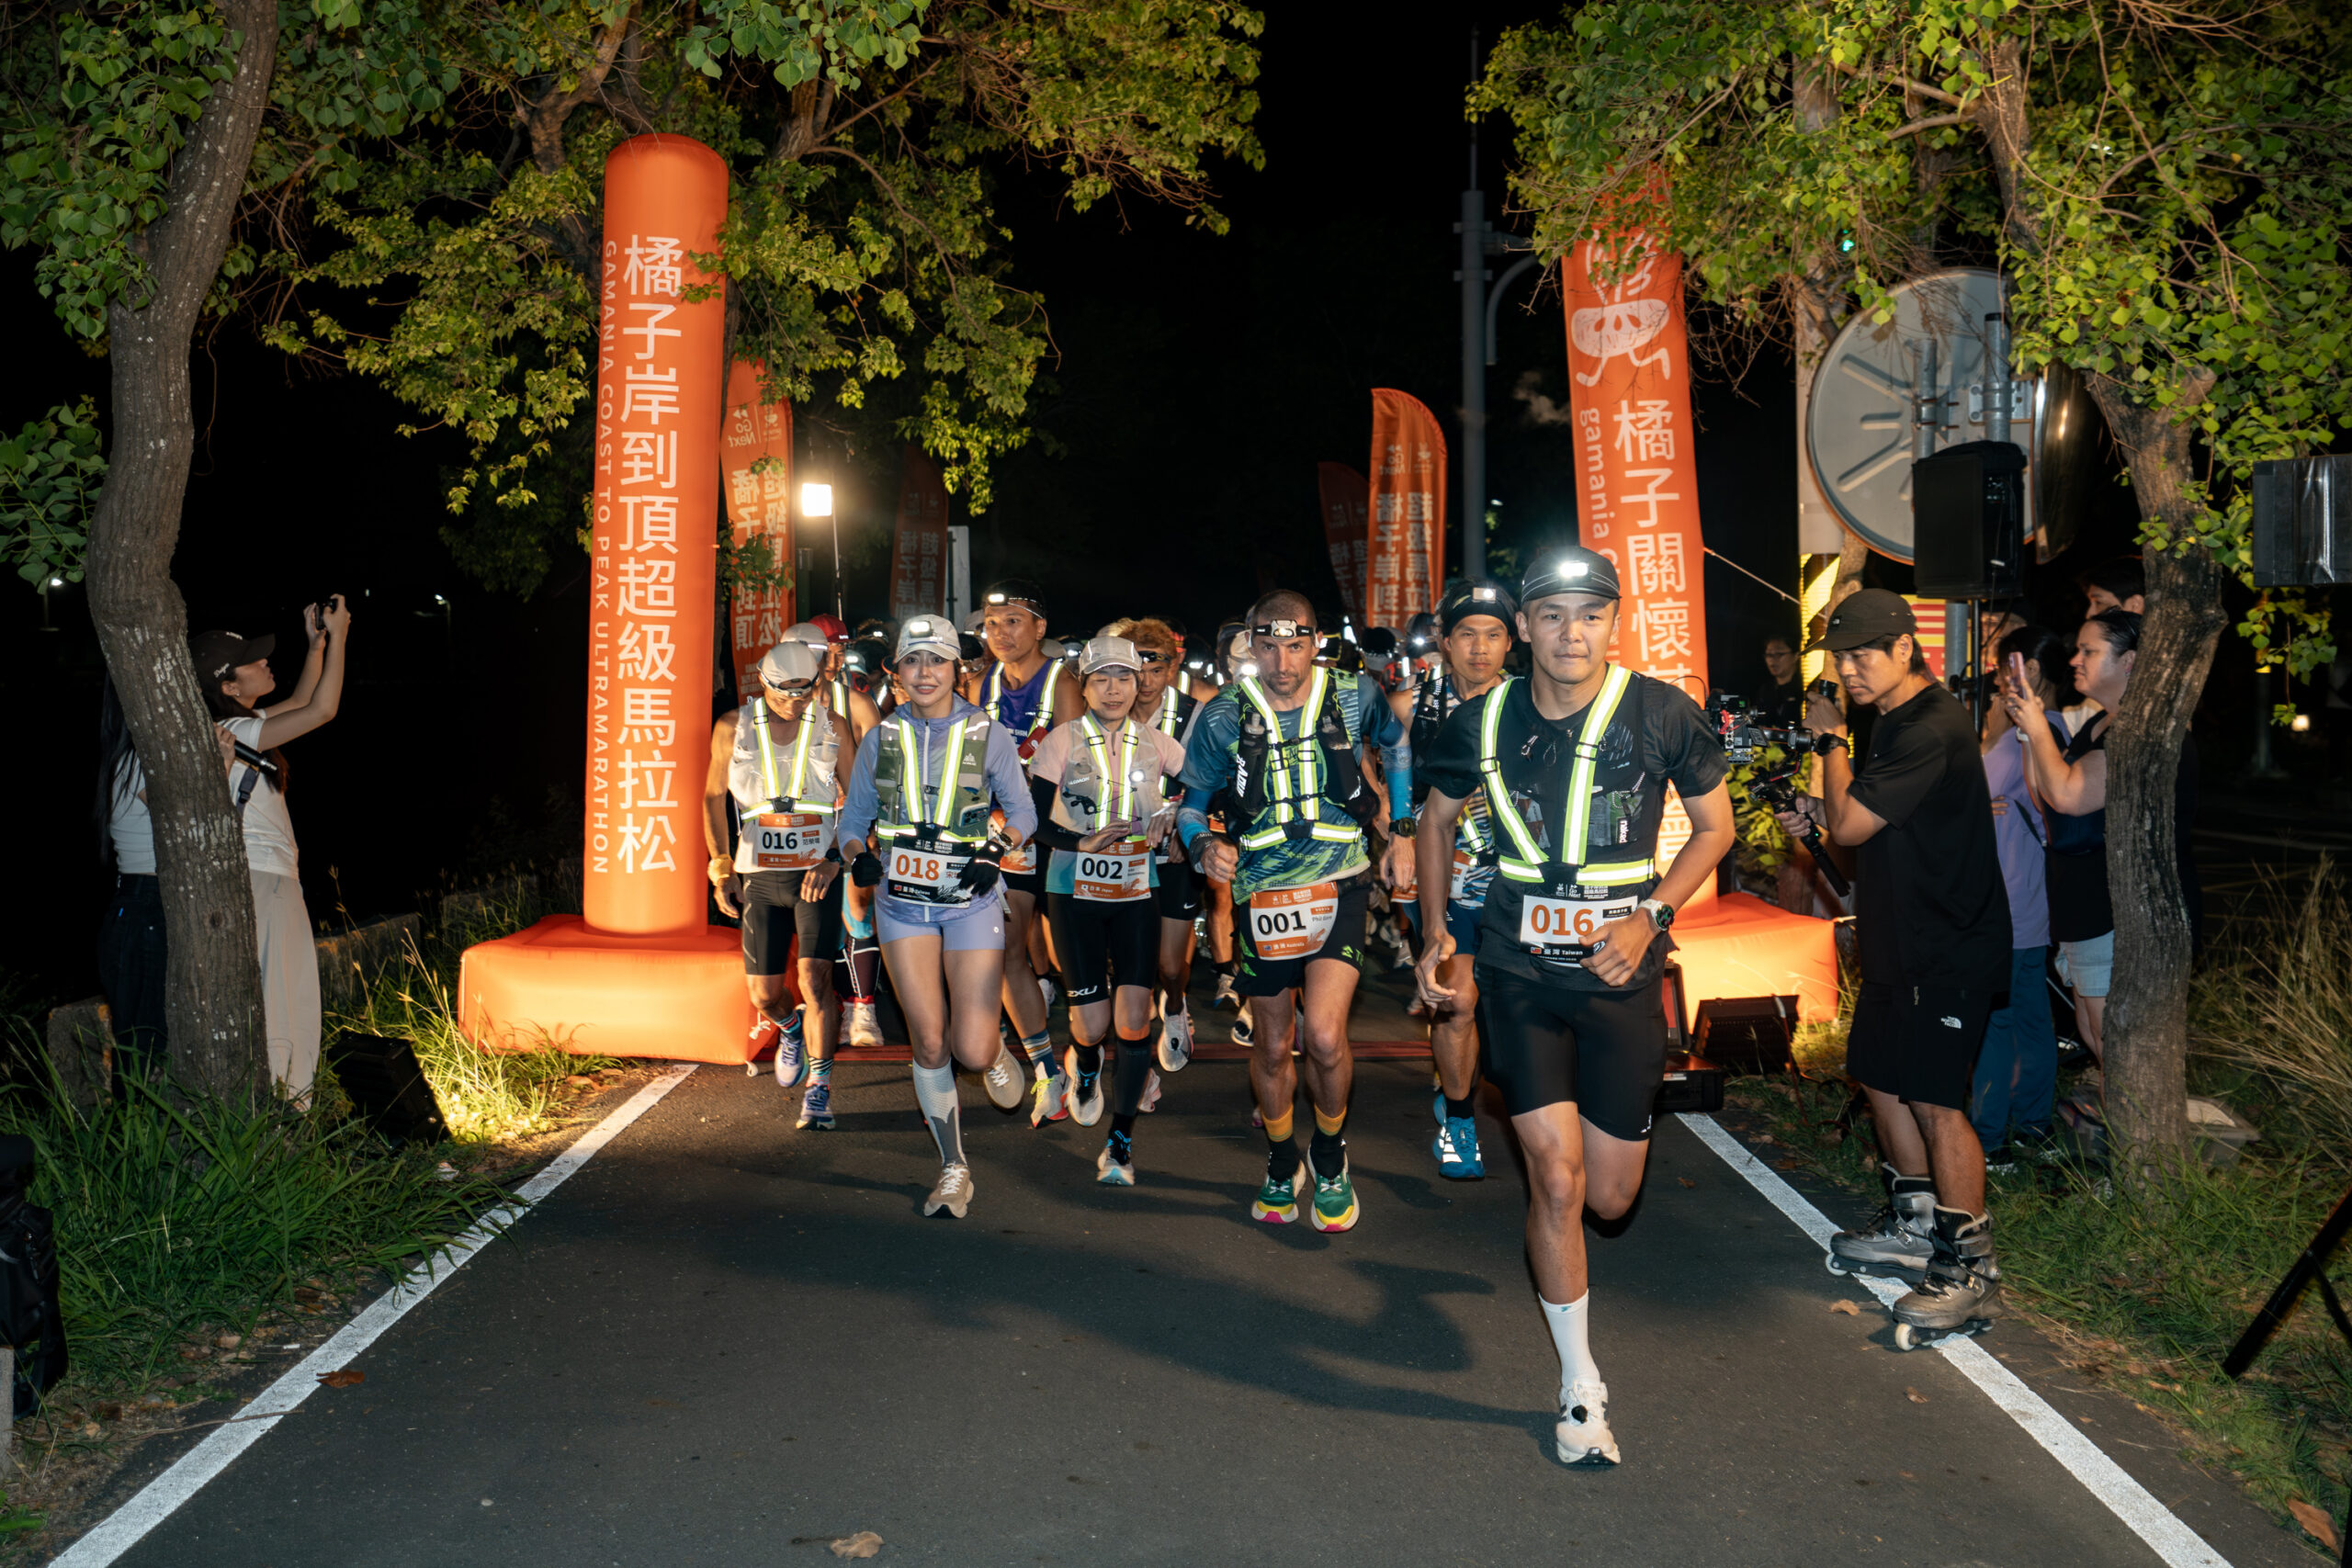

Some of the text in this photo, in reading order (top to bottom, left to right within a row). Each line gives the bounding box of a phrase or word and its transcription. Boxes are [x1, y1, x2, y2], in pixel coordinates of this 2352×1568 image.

[1580, 407, 1615, 539] gamania
[593, 240, 617, 874] GAMANIA COAST TO PEAK ULTRAMARATHON
[616, 233, 682, 874] 橘子岸到頂超級馬拉松
[762, 831, 797, 850] 016
[1620, 820, 1630, 843] naked
[896, 854, 939, 881] 018
[1081, 857, 1123, 879] 002
[1257, 910, 1306, 935] 001
[1531, 905, 1594, 936] 016
